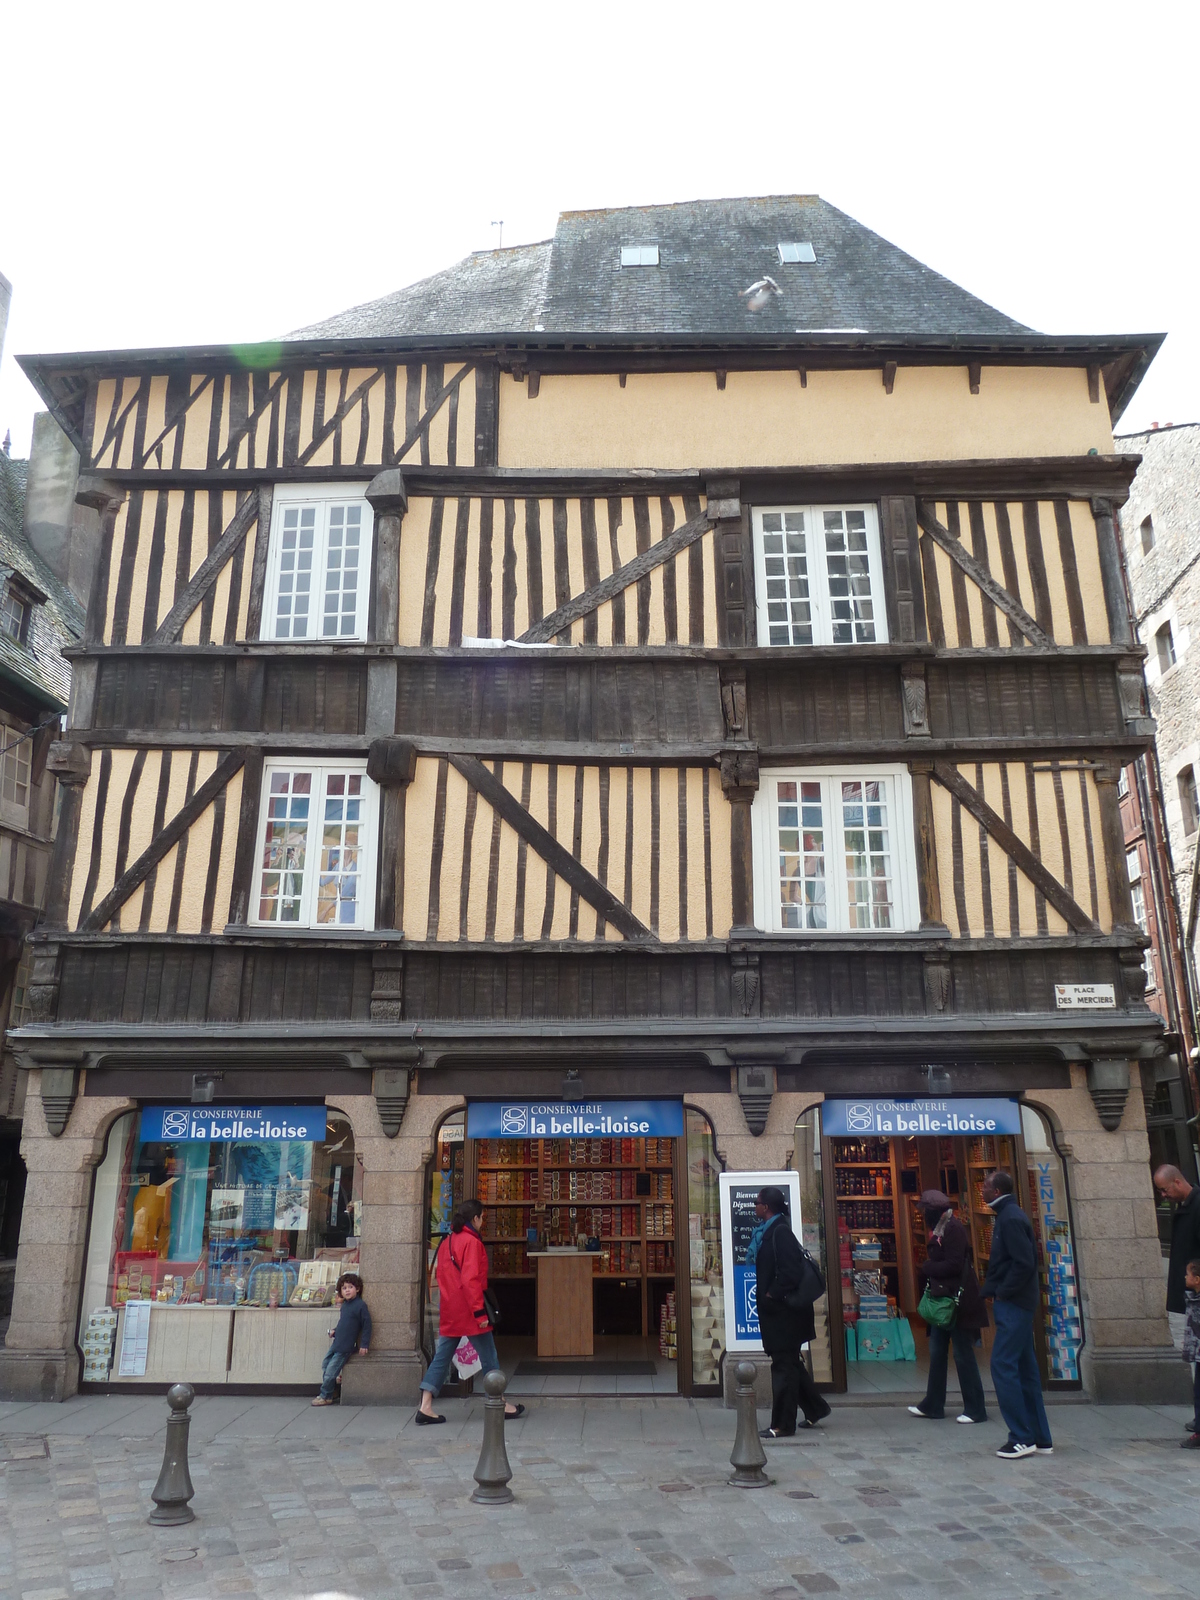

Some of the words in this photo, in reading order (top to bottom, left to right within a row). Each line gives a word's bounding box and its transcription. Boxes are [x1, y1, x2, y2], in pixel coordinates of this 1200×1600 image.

[531, 1105, 603, 1114] CONSERVERIE
[876, 1103, 948, 1112] CONSERVERIE
[192, 1110, 262, 1119] CONSERVERIE
[530, 1117, 546, 1134] la
[551, 1116, 650, 1134] belle-iloise
[876, 1114, 893, 1131] la
[896, 1113, 996, 1131] belle-iloise
[191, 1121, 206, 1138] la
[210, 1121, 307, 1138] belle-iloise
[736, 1191, 759, 1199] Bienven
[1037, 1163, 1056, 1226] VENTE
[440, 1169, 453, 1232] VENTE
[732, 1201, 757, 1211] Dégusta
[737, 1323, 746, 1333] la
[747, 1323, 761, 1333] bel
